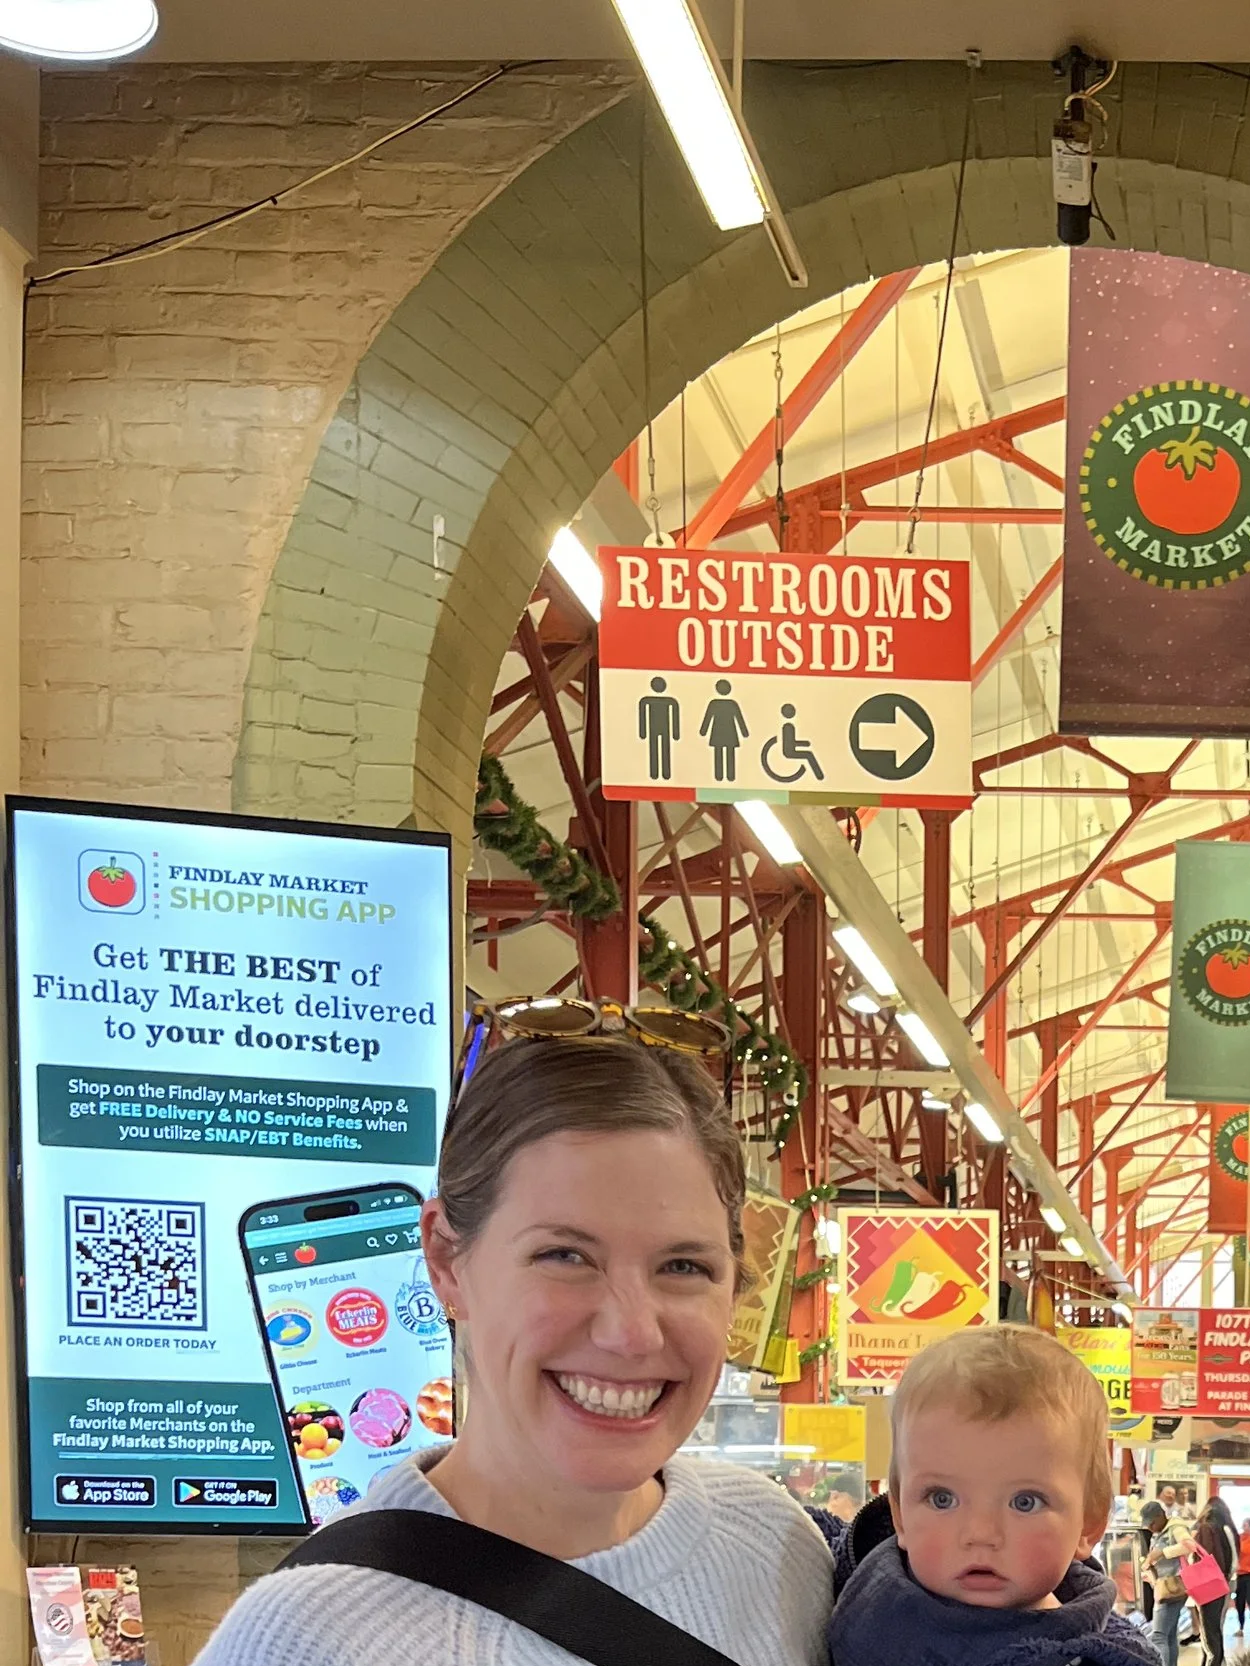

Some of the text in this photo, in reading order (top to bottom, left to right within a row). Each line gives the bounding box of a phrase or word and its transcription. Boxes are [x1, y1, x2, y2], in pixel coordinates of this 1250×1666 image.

[615, 555, 953, 624] RESTROOMS
[677, 616, 895, 674] OUTSIDE
[169, 866, 368, 895] FINDLAY MARKET
[170, 886, 396, 924] SHOPPING APP
[93, 942, 383, 987] Get THE BEST of
[33, 974, 436, 1025] Findlay Market delivered
[104, 1015, 381, 1062] to your doorstep
[68, 1078, 409, 1115] Shop on the Findlay Market Shopping App &
[69, 1101, 408, 1132] get FREE Delivery & NO Service Fees when
[119, 1125, 362, 1149] you utilize SNAP/EBT Benefits.
[268, 1271, 357, 1294] Shop by Merchant
[338, 1315, 378, 1330] MEATS
[58, 1335, 217, 1350] PLACE AN ORDER TODAY
[292, 1378, 351, 1395] Department
[1207, 1391, 1248, 1401] PARADE
[86, 1398, 239, 1418] Shop from all of your
[1219, 1402, 1231, 1411] AT
[69, 1415, 255, 1433] favorite Merchants on the
[52, 1433, 276, 1453] Findlay Market Shopping App.
[83, 1480, 120, 1488] Download
[132, 1481, 145, 1489] the
[83, 1488, 149, 1503] App Store
[204, 1490, 272, 1505] Google Play
